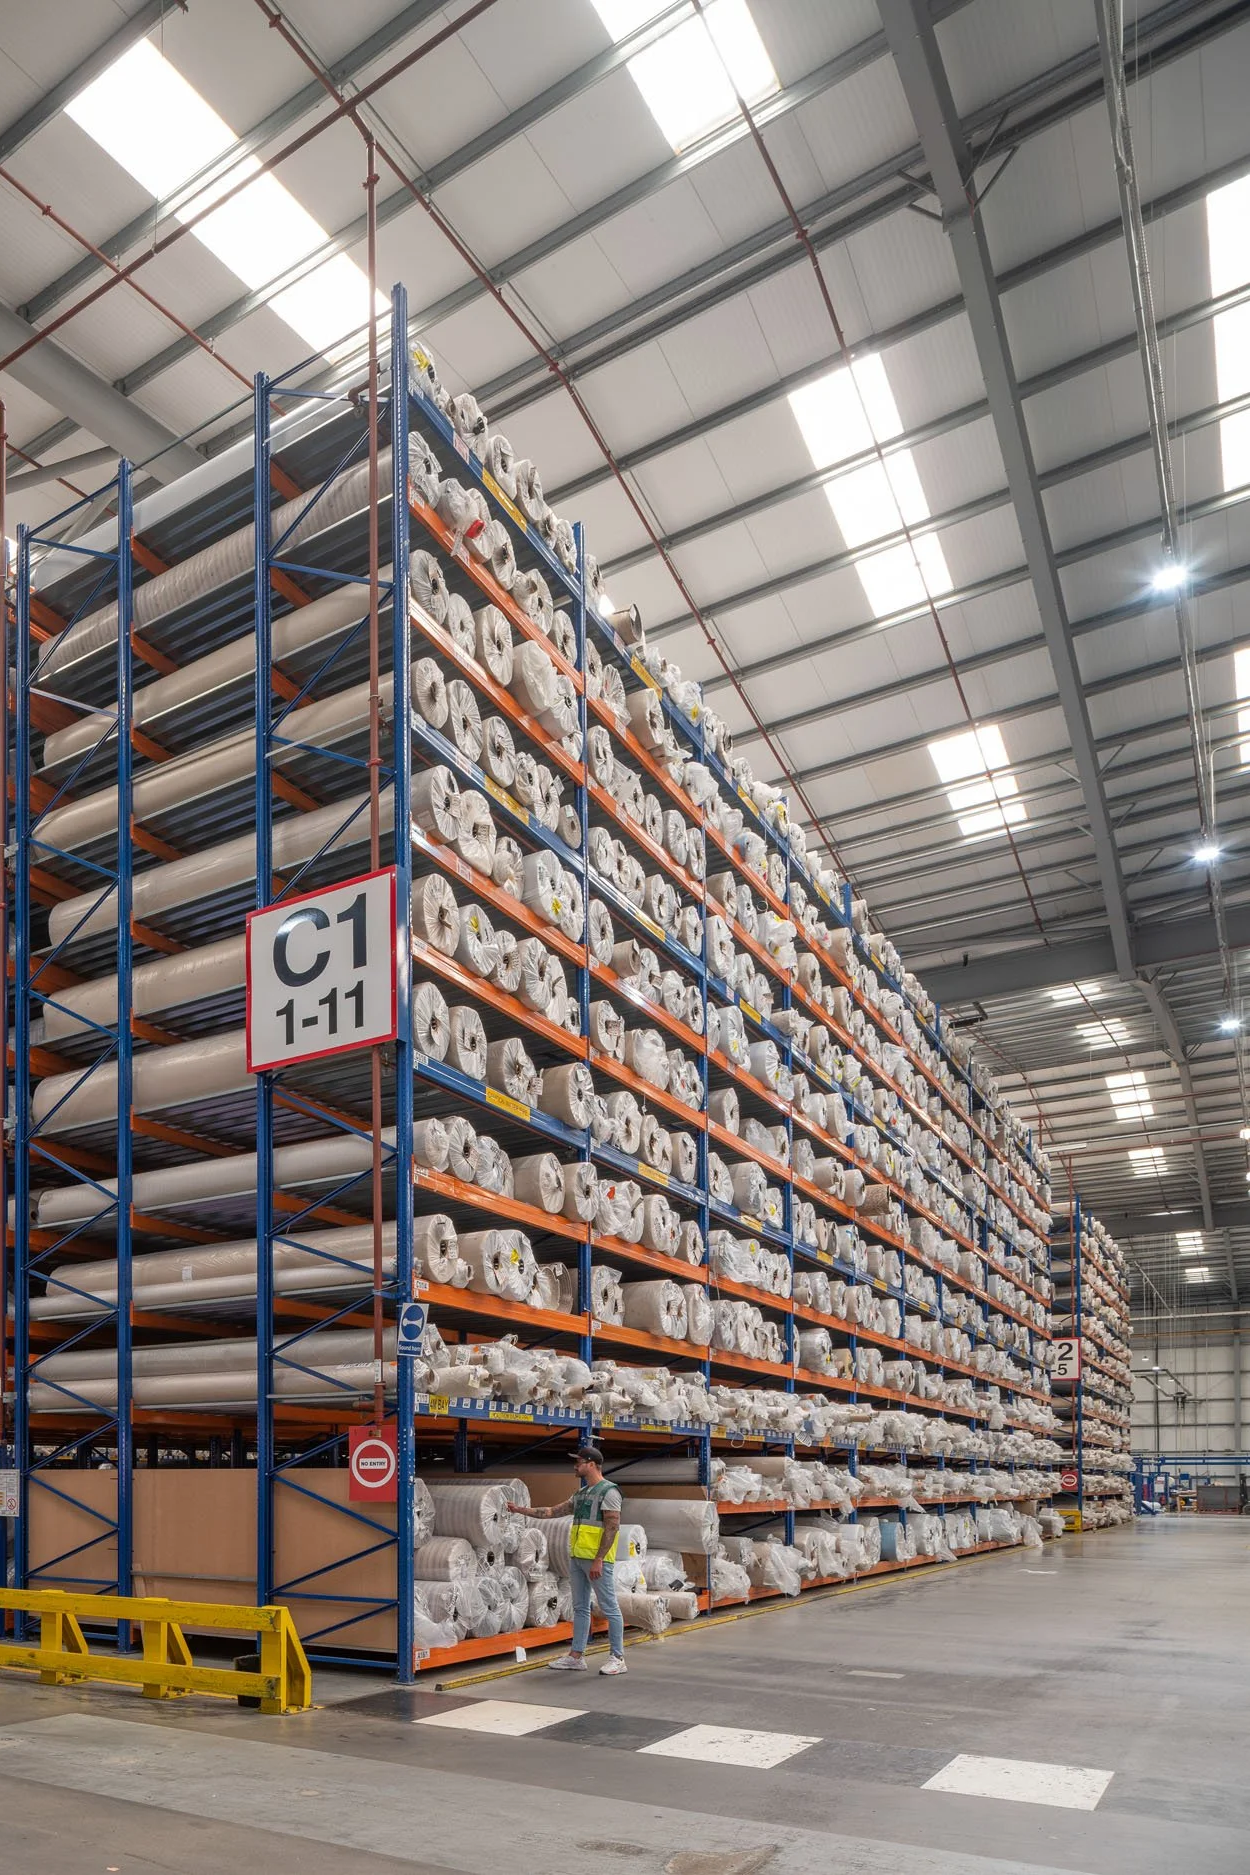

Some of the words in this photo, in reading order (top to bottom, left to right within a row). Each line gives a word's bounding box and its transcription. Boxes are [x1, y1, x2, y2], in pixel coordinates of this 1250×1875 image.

[272, 892, 368, 988] C1
[276, 980, 365, 1046] 1-11
[1051, 1363, 1067, 1375] -5
[1058, 1342, 1073, 1361] 2
